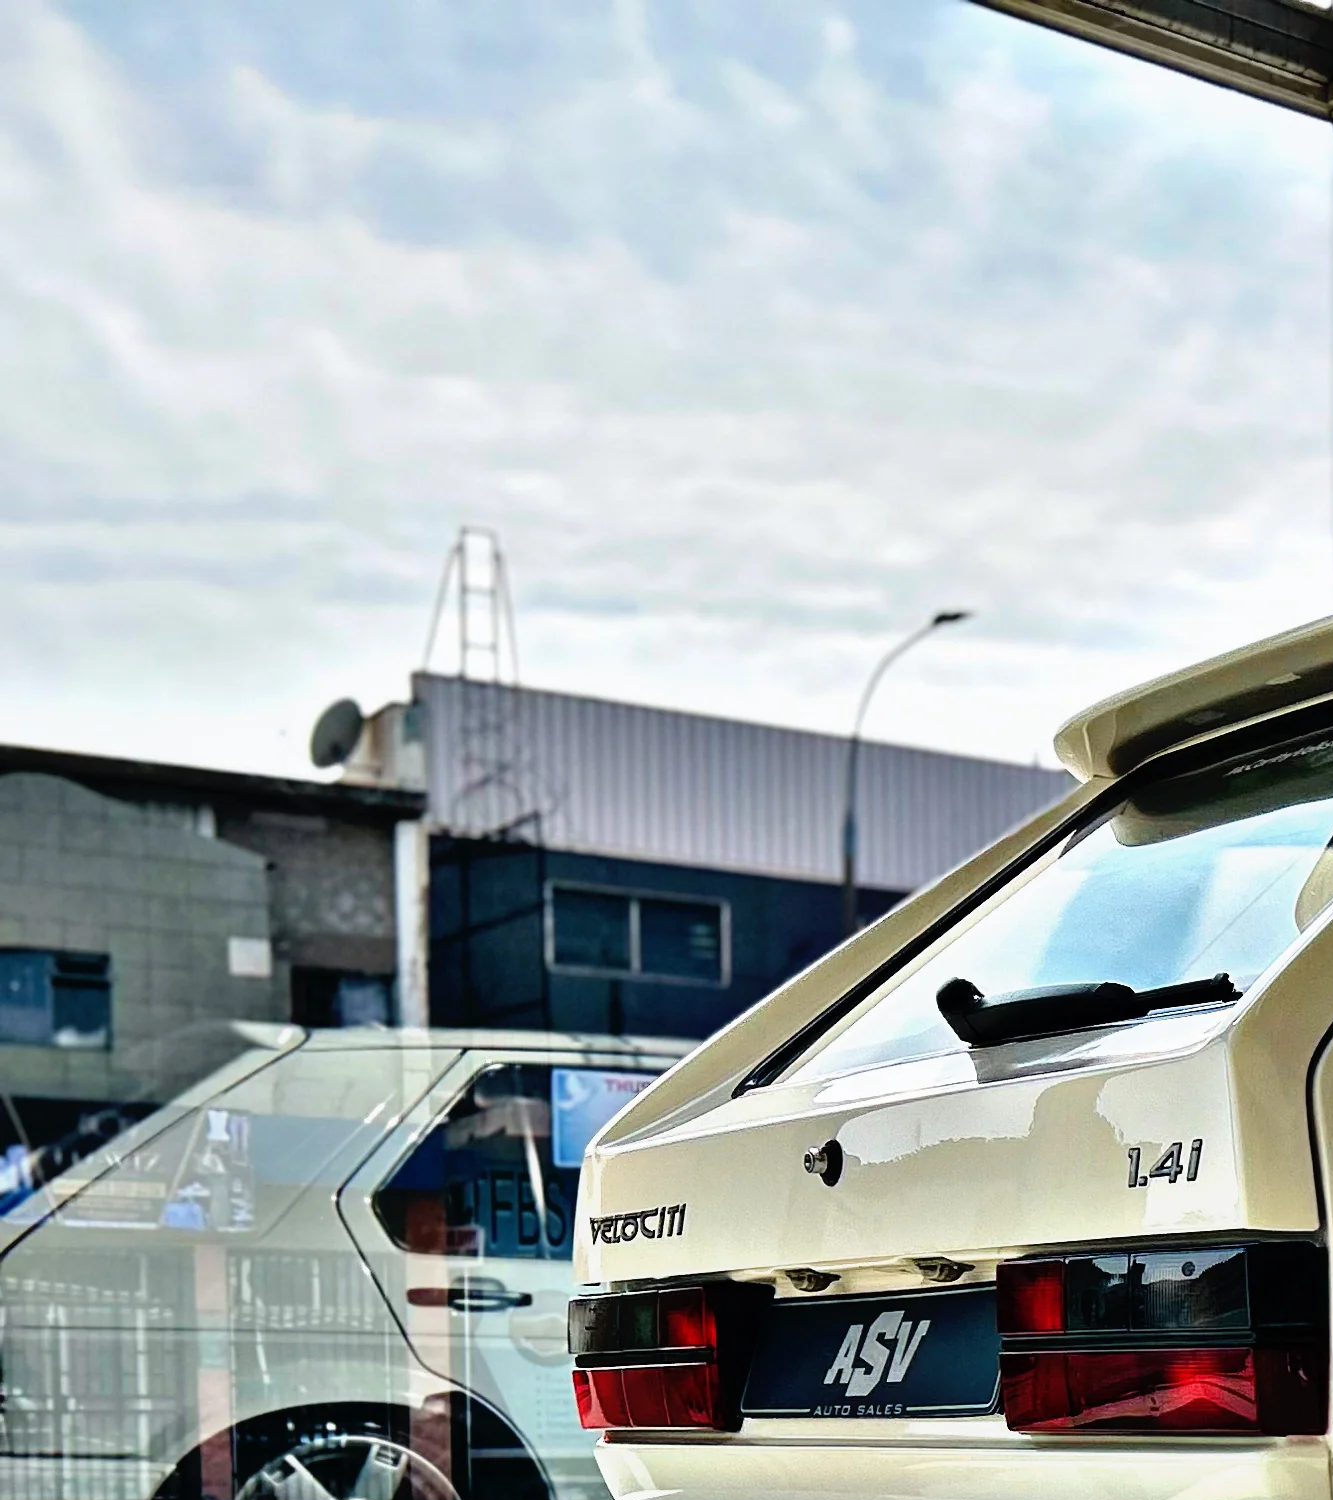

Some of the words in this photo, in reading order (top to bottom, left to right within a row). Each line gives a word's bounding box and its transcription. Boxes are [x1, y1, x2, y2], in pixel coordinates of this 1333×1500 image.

[590, 1203, 688, 1245] VELOCITI
[823, 1310, 931, 1397] ASV
[813, 1405, 851, 1416] AUTO
[856, 1404, 904, 1416] SALES
